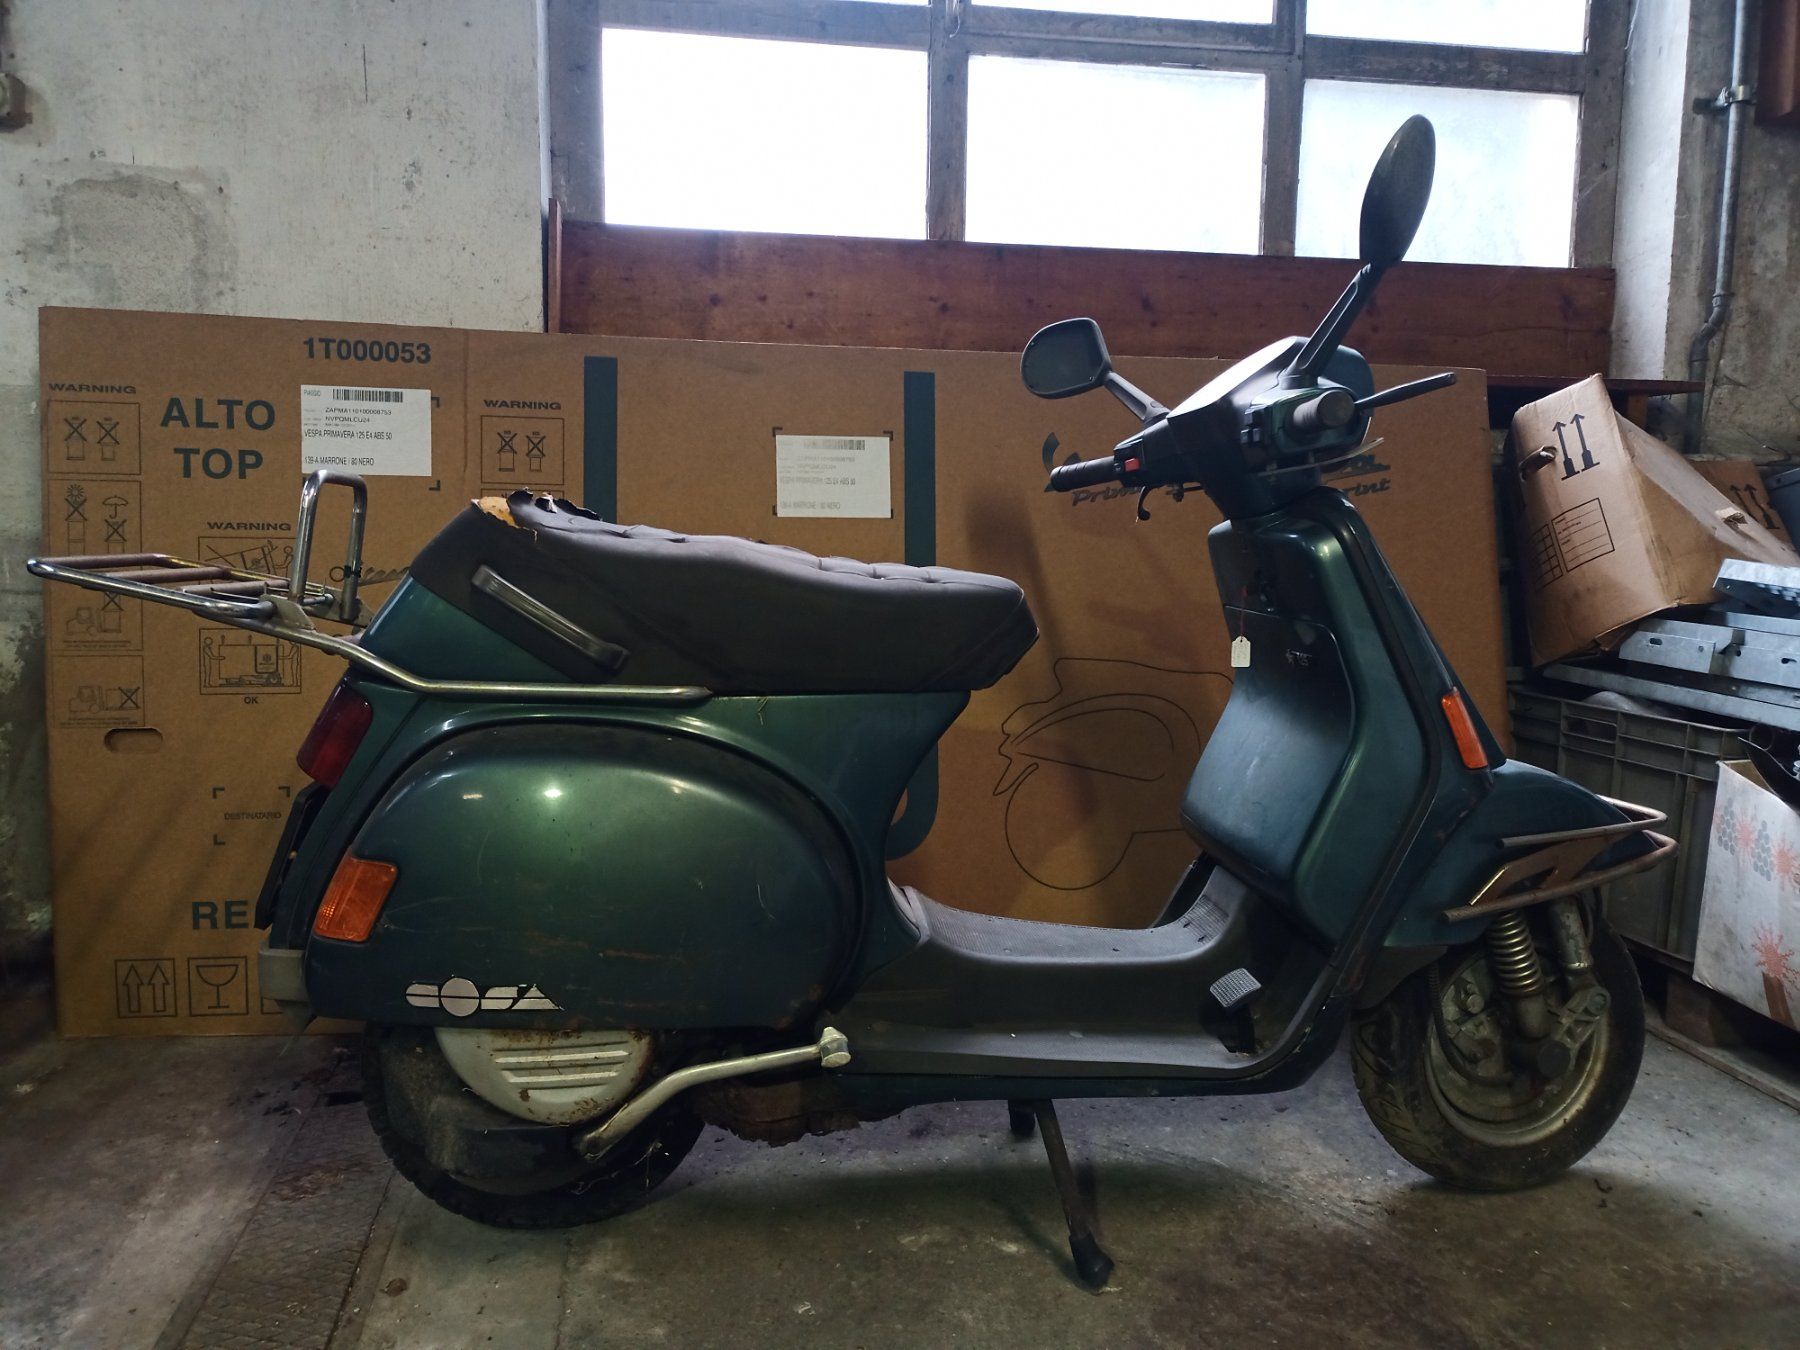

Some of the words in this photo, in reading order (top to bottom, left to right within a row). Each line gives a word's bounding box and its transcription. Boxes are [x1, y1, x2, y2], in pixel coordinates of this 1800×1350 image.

[303, 337, 432, 364] 1T000053
[48, 383, 137, 394] WARNING
[483, 399, 562, 410] WARNING
[160, 397, 276, 431] ALTO
[304, 429, 322, 438] VESPA
[323, 429, 355, 440] PRIMAVERA
[173, 448, 264, 480] TOP
[320, 457, 347, 466] MARRONE
[358, 458, 374, 466] NERO
[207, 521, 292, 532] WARNING
[244, 696, 258, 704] OK
[192, 900, 249, 930] RE
